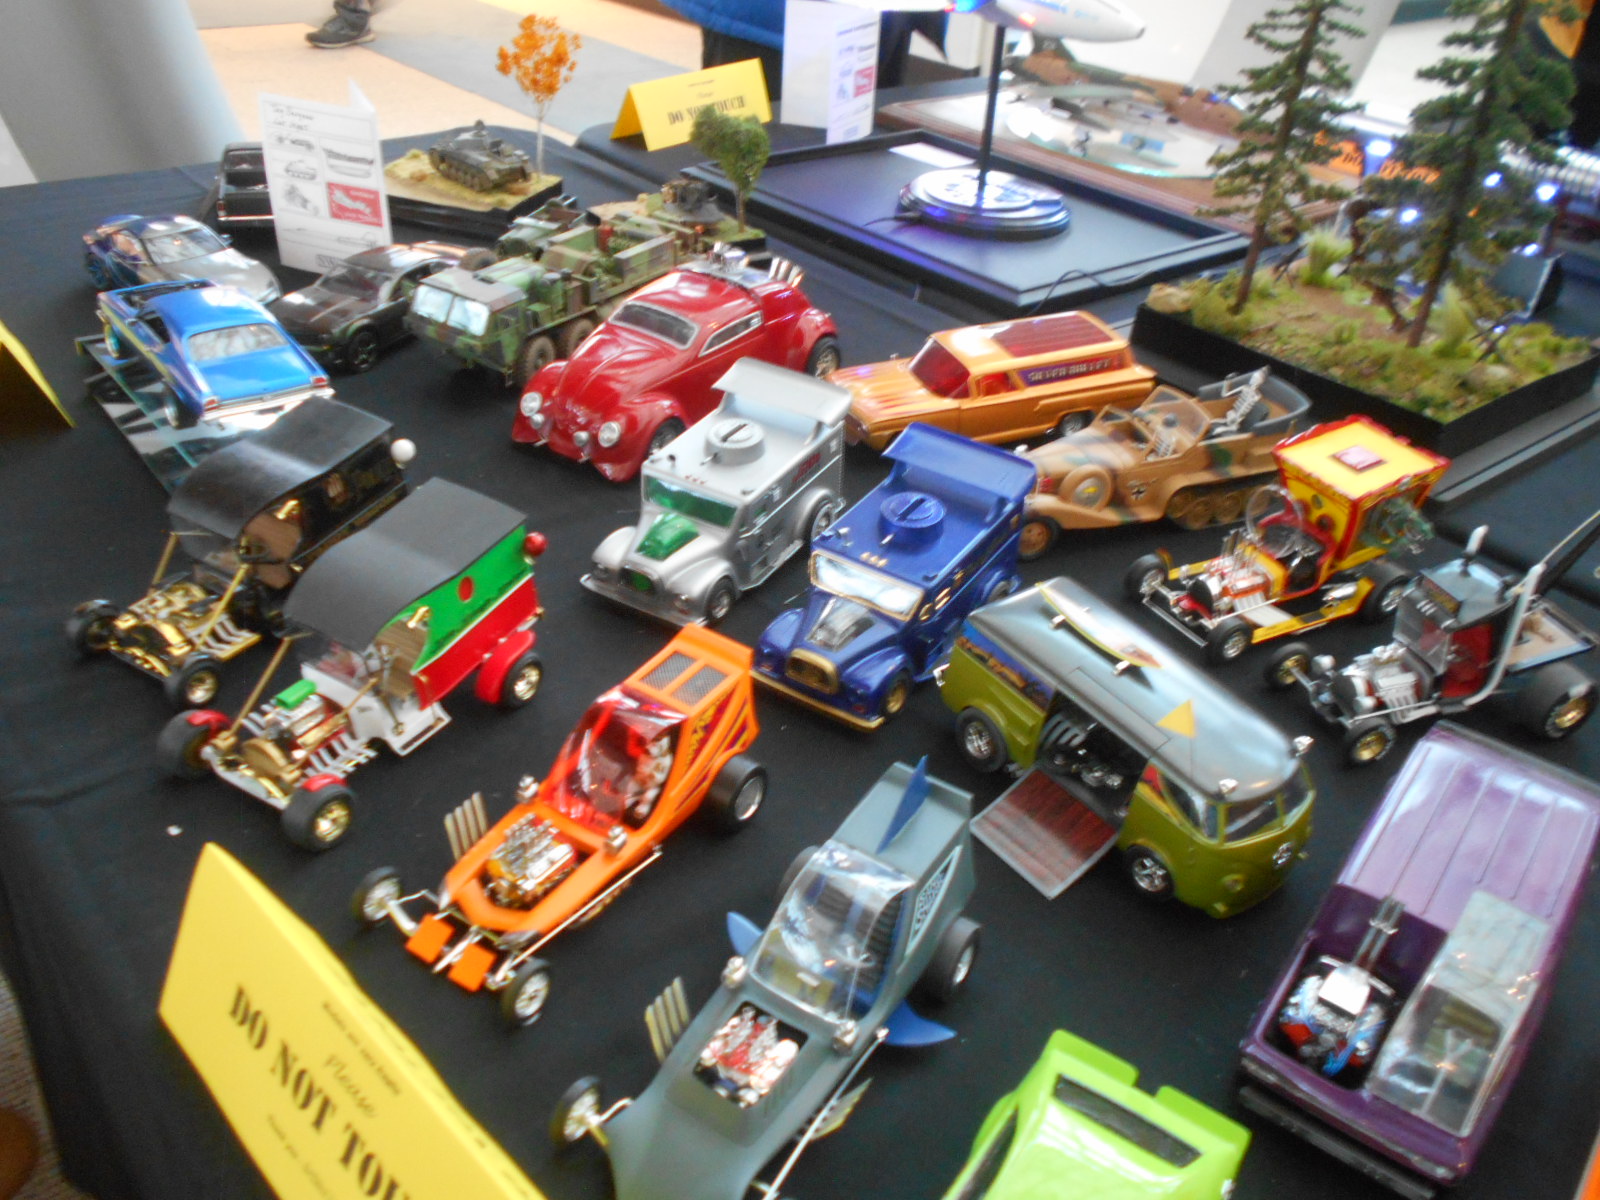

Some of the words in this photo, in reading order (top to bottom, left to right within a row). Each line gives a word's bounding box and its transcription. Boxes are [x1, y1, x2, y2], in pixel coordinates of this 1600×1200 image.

[668, 110, 685, 125] DO
[228, 983, 269, 1051] DO
[269, 1039, 337, 1132] NOT
[322, 1053, 377, 1119] Please
